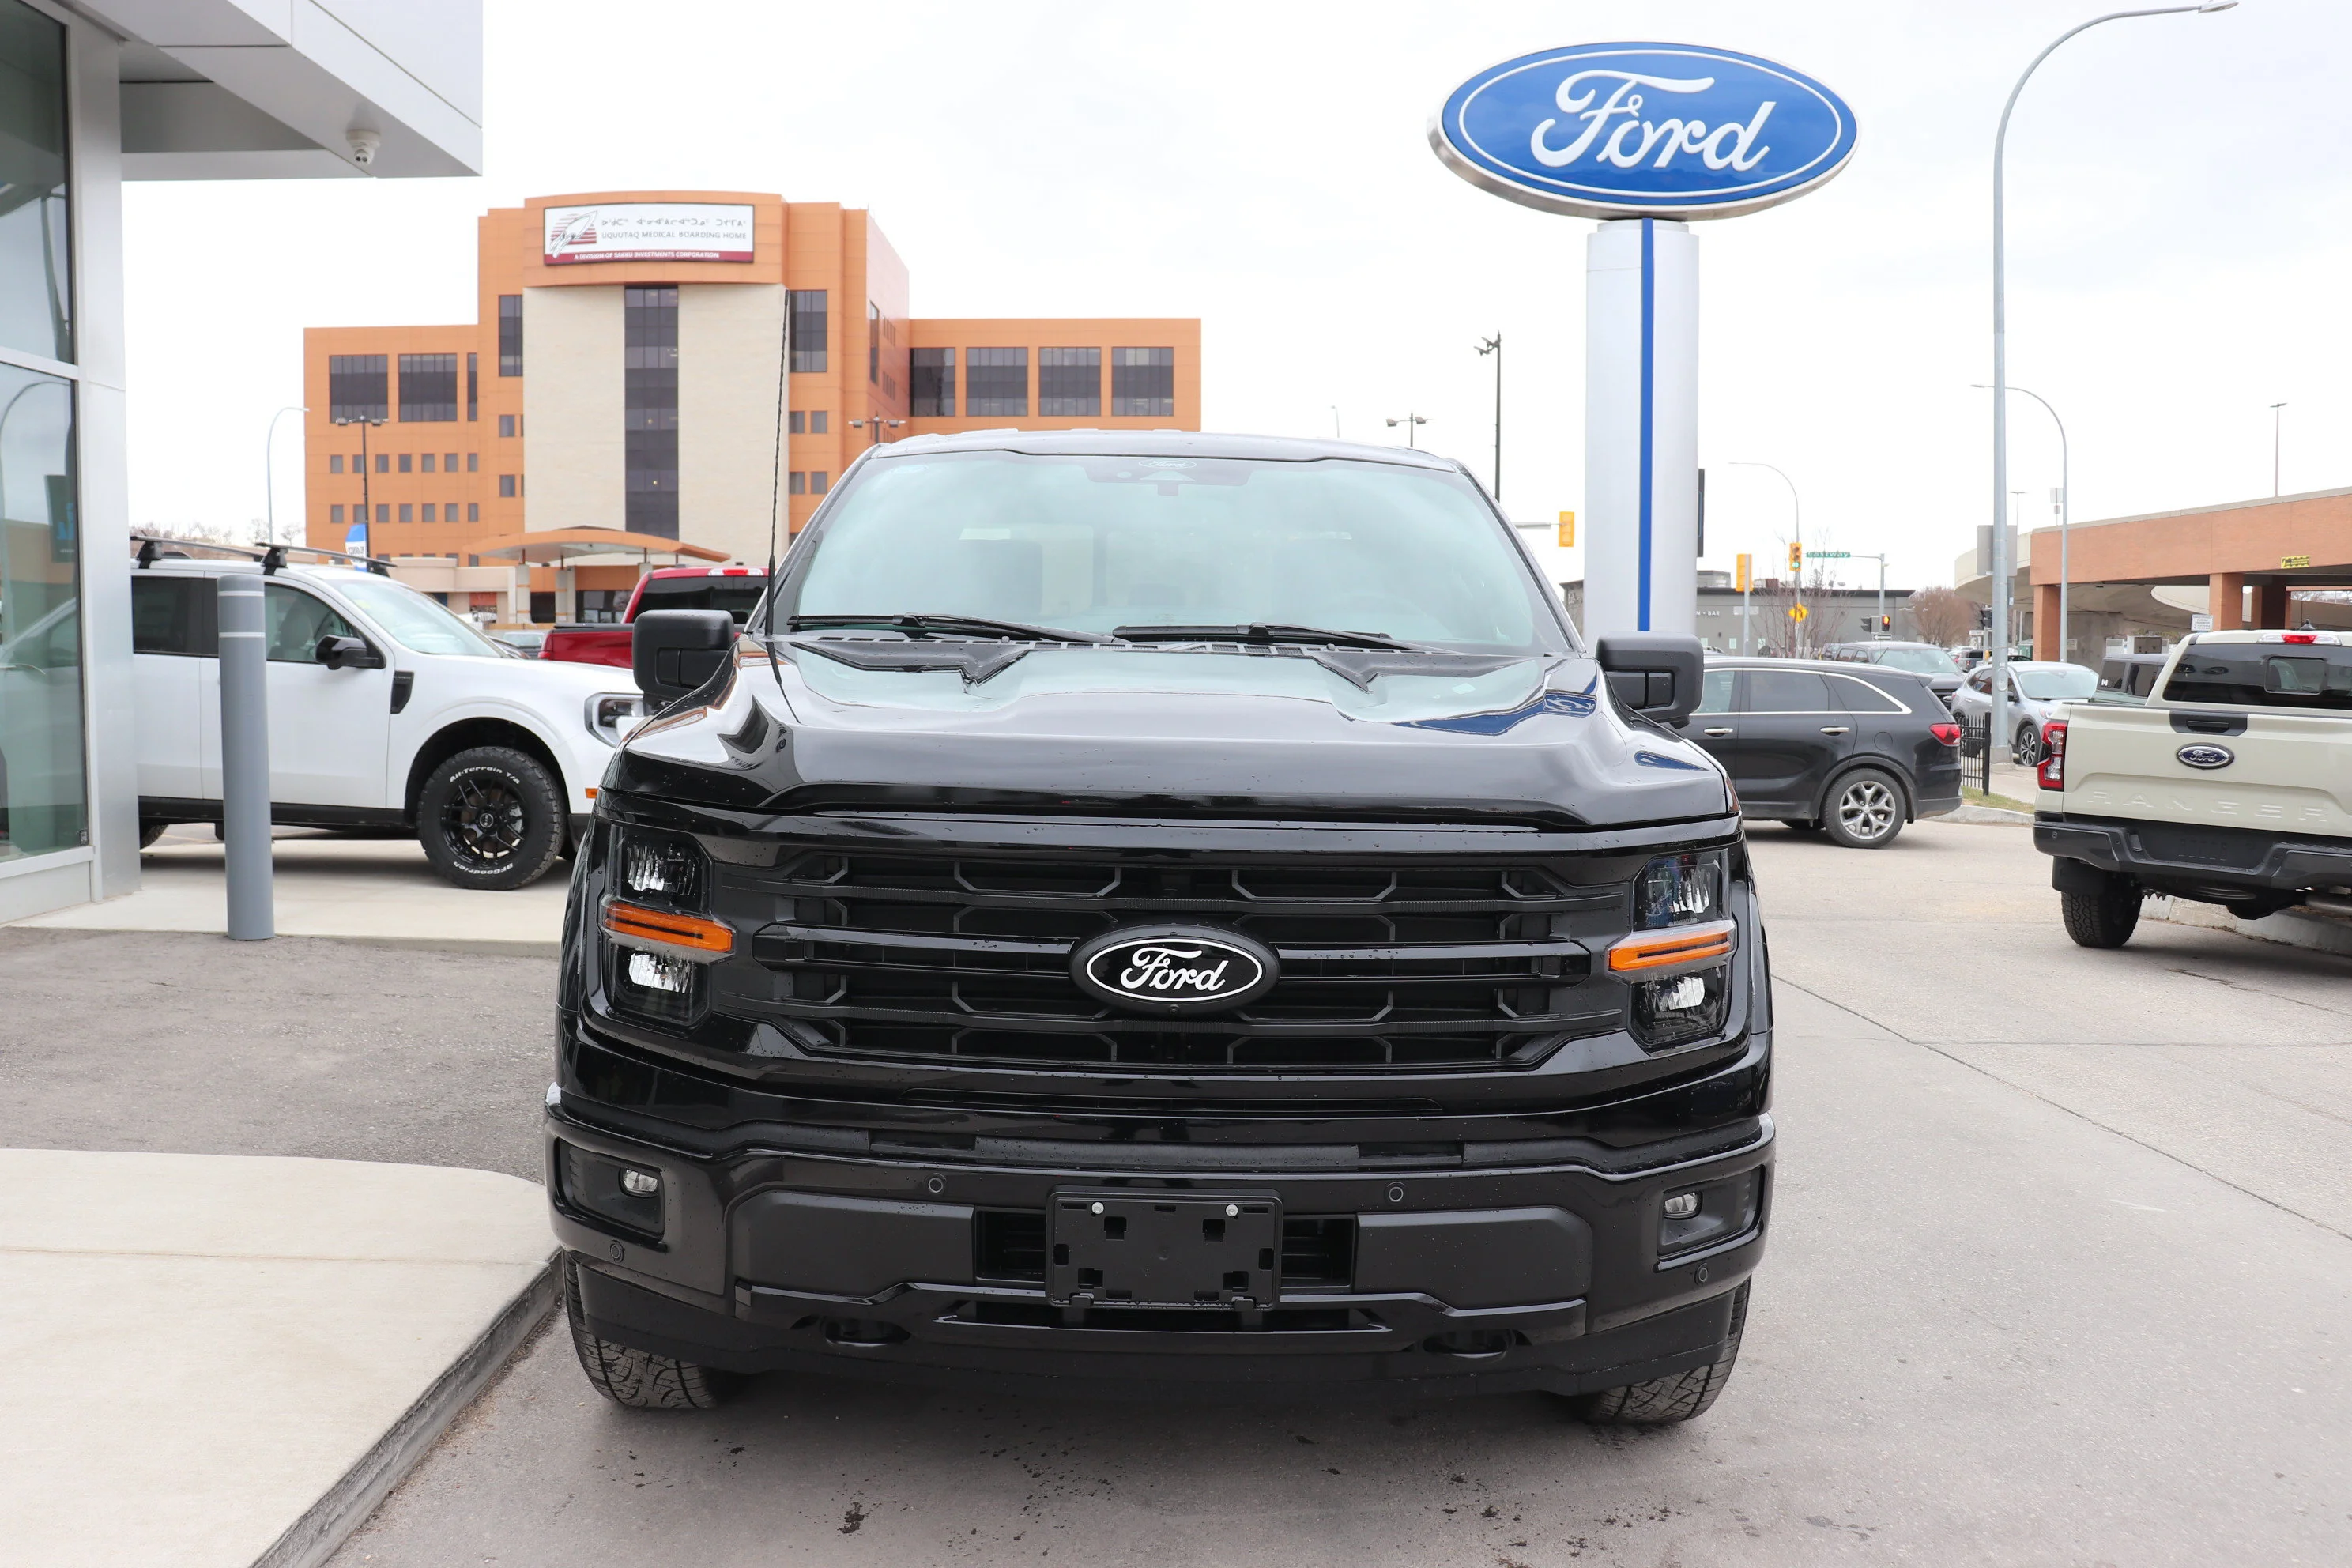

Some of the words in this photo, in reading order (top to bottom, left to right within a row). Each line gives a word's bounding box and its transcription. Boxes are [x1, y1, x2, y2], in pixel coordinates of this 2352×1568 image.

[1530, 69, 1777, 172] Ford
[601, 231, 639, 240] UQUUTAQ
[2189, 749, 2218, 763] Ford
[506, 771, 521, 785] T/A
[2086, 790, 2328, 822] RANGER
[453, 861, 514, 875] BFGoodrich
[1120, 946, 1229, 991] Ford
